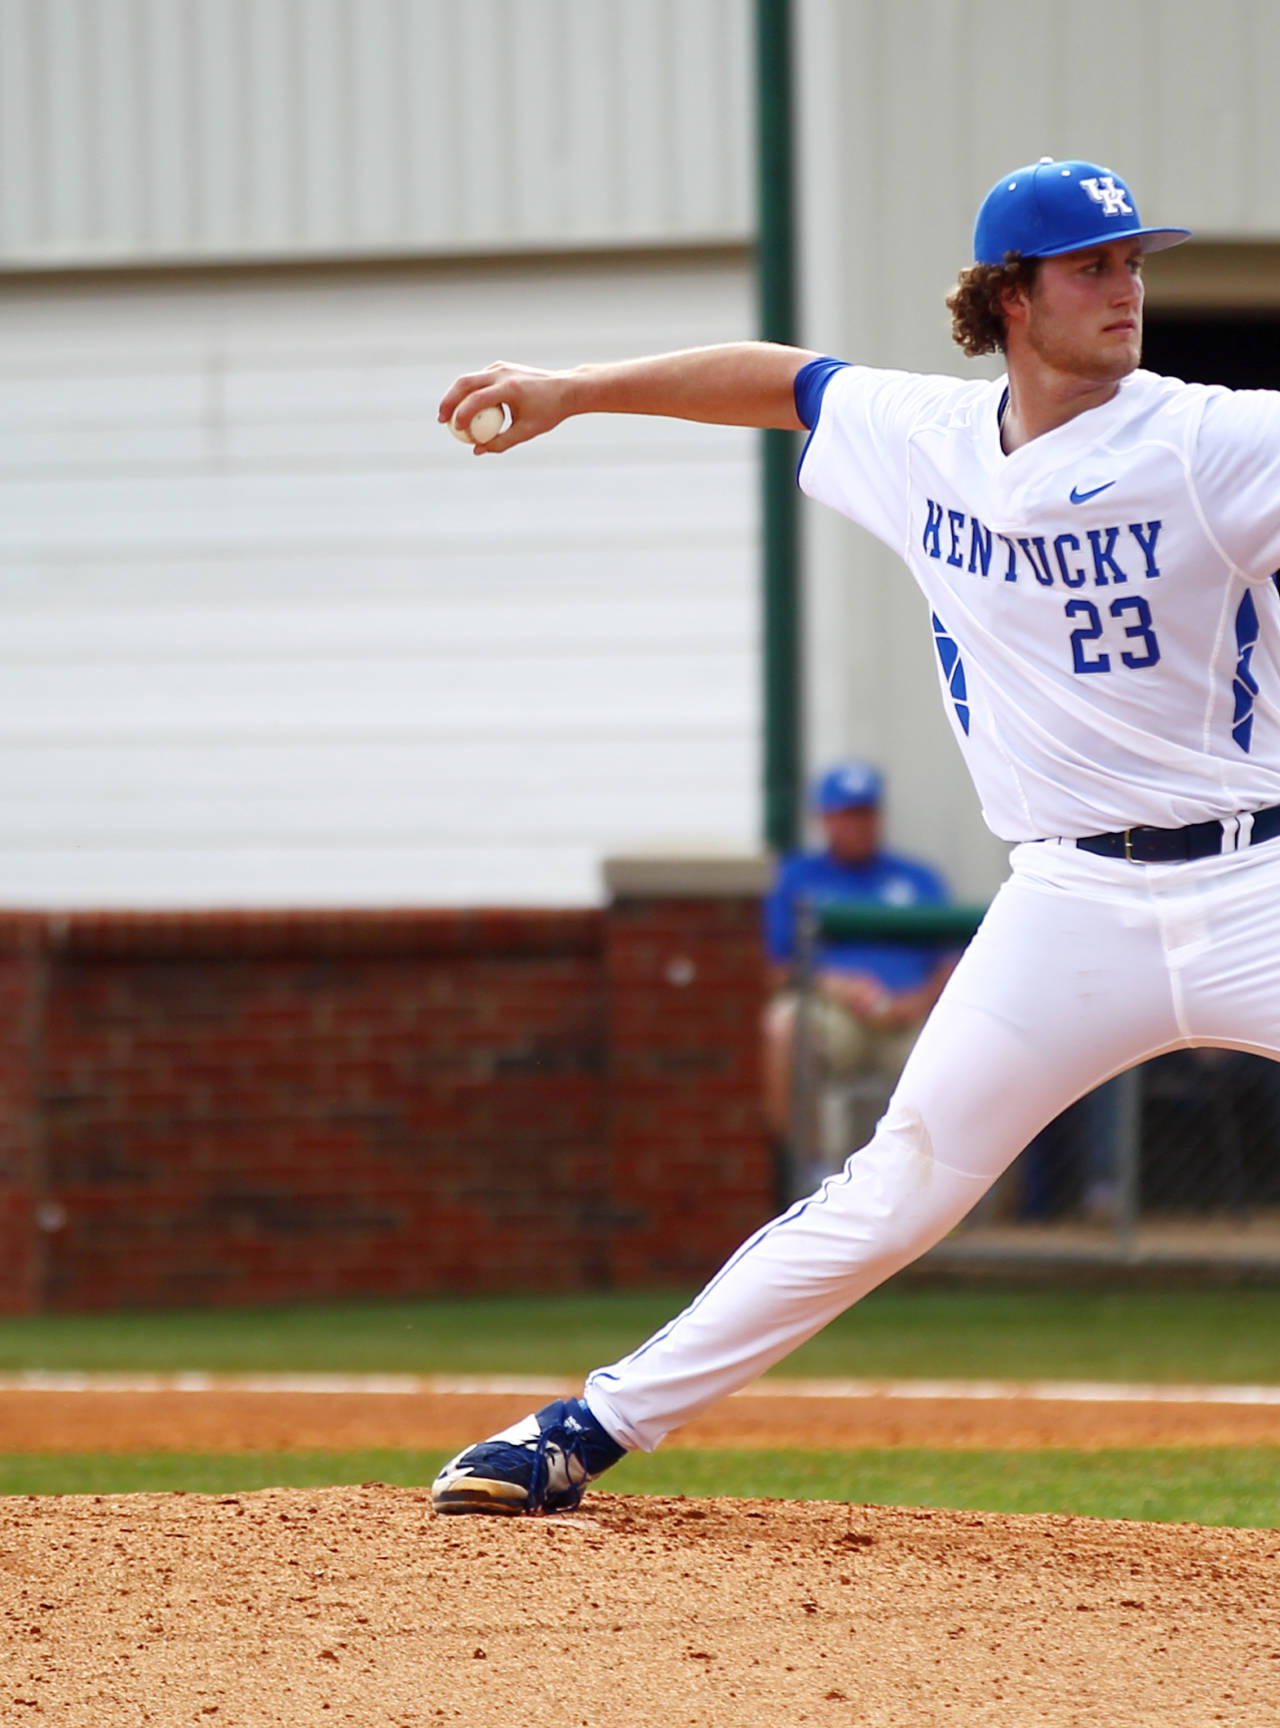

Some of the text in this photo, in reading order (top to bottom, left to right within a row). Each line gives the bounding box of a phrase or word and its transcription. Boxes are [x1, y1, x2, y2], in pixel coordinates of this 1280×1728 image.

[1079, 177, 1133, 216] UK
[923, 498, 1162, 588] KENTUCKY
[1064, 595, 1161, 674] 23
